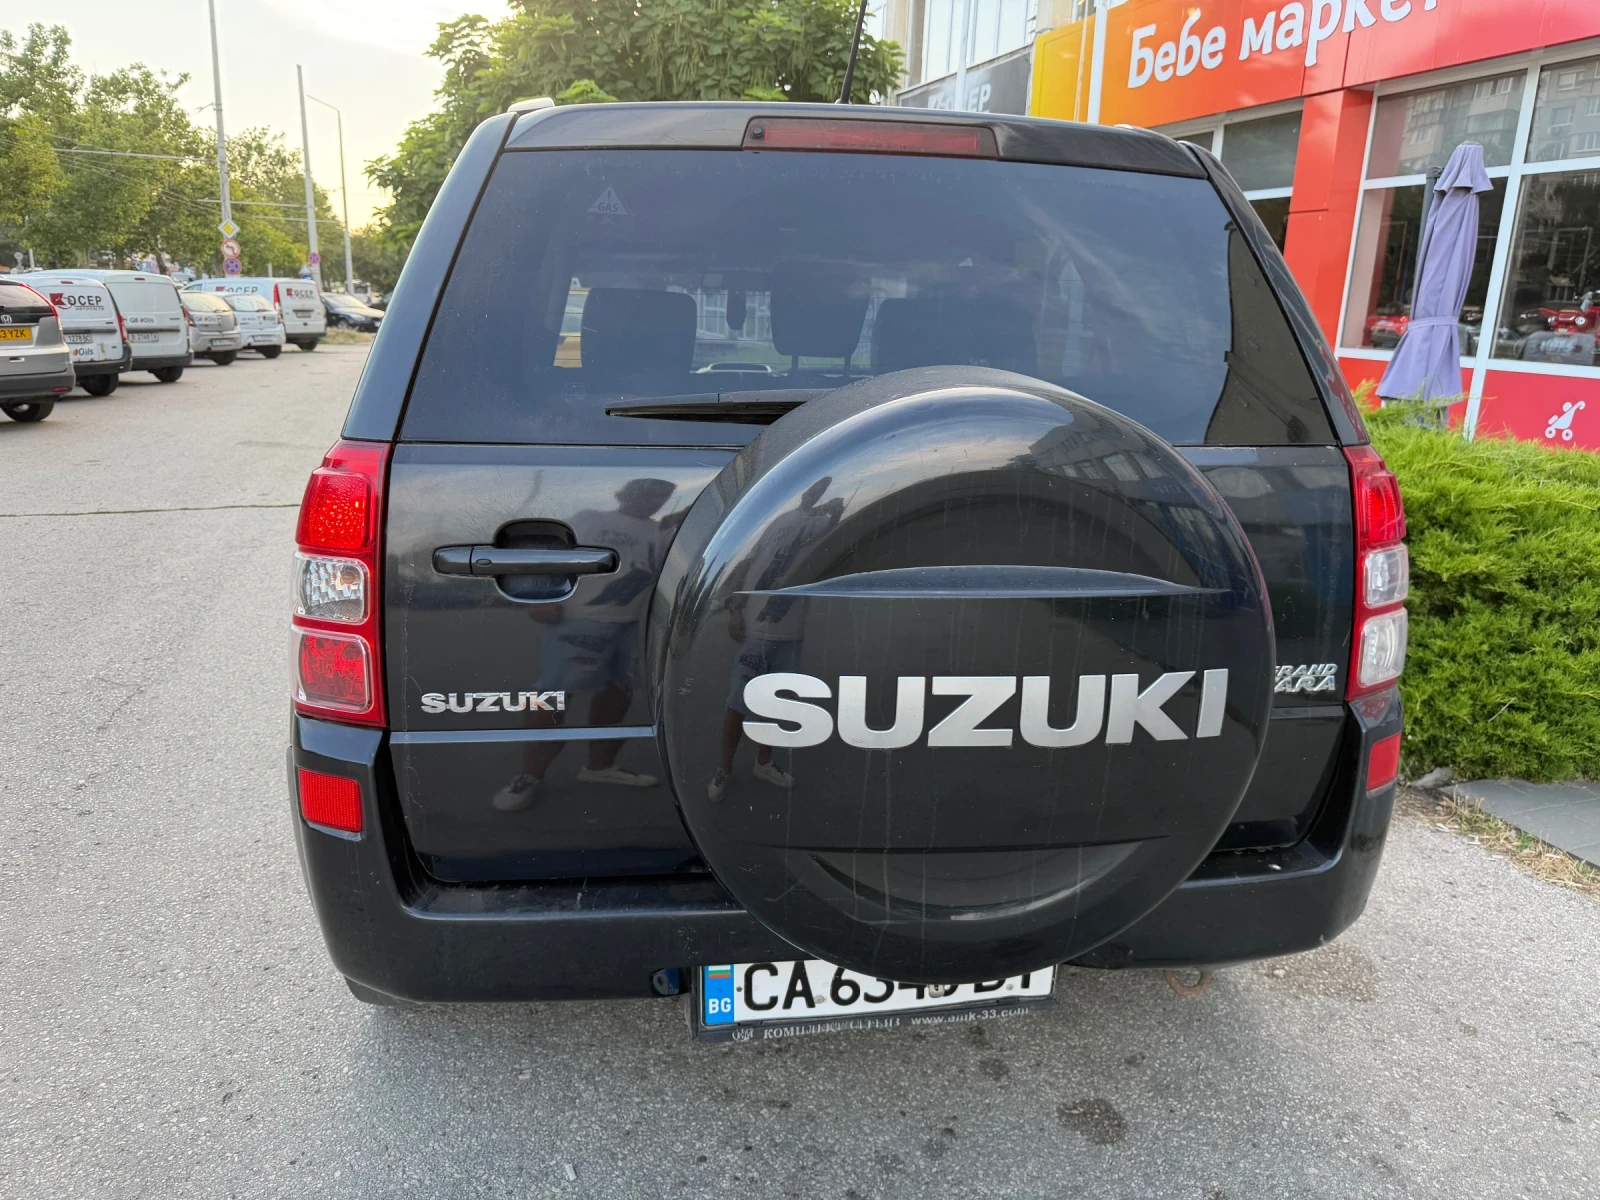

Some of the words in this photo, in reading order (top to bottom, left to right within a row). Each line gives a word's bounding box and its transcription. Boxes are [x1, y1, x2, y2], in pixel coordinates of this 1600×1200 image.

[1127, 8, 1226, 89] Бебе
[1238, 0, 1438, 67] марке
[598, 202, 619, 213] GAS
[8, 328, 26, 339] YZK
[78, 347, 94, 357] Oils
[420, 690, 566, 714] SUZUKI
[742, 668, 1229, 749] SUZUKI
[743, 962, 817, 1011] CA
[708, 997, 732, 1014] BG
